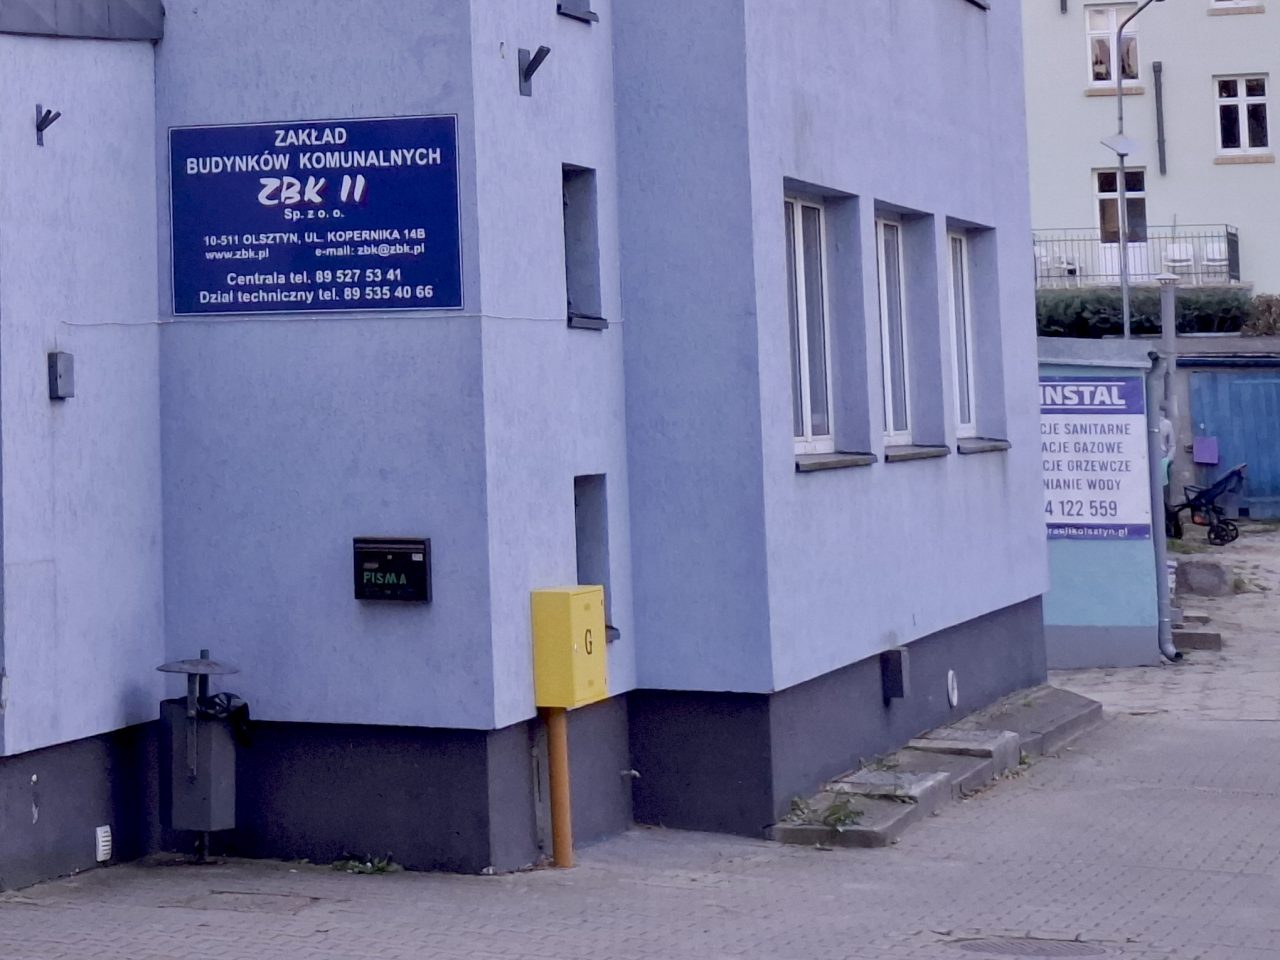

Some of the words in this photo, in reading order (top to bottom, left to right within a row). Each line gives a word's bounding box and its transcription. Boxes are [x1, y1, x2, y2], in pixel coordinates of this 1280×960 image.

[275, 127, 346, 147] ZAKŁAD
[187, 152, 289, 174] BUDYNKÓW
[300, 148, 441, 170] KOMUNALNYCH
[257, 175, 326, 205] ZBK
[284, 209, 304, 221] Sp.
[307, 210, 315, 219] z
[318, 209, 329, 218] o.
[333, 209, 345, 218] o.
[204, 235, 239, 246] 10-511
[243, 233, 301, 245] OLSZTYN,
[328, 230, 400, 242] KOPERNIKA
[403, 229, 425, 239] 14B
[206, 248, 269, 260] www.zbk.pl
[315, 245, 355, 257] e-mail:
[357, 243, 424, 257] zbk@zbk.pl
[227, 271, 285, 285] Centrala
[290, 271, 311, 284] tel.
[315, 270, 332, 283] 89
[336, 269, 360, 282] 527
[365, 269, 382, 281] 53
[386, 268, 401, 280] 41
[238, 290, 314, 304] techniczny
[319, 289, 339, 300] tel.
[344, 288, 361, 300] 89
[365, 287, 390, 299] 535
[394, 287, 411, 298] 40
[416, 286, 433, 297] 66
[1065, 423, 1131, 435] SANITARNE
[1042, 442, 1069, 454] ACJE
[1074, 442, 1124, 454] GAZOWE
[1043, 460, 1062, 472] CJE
[1068, 460, 1131, 472] GRZEWCZE
[1087, 479, 1121, 490] WODY
[1045, 500, 1053, 516] 4
[1059, 500, 1084, 516] 122
[1090, 501, 1117, 517] 559
[363, 571, 407, 585] PISMA
[584, 628, 593, 655] G
